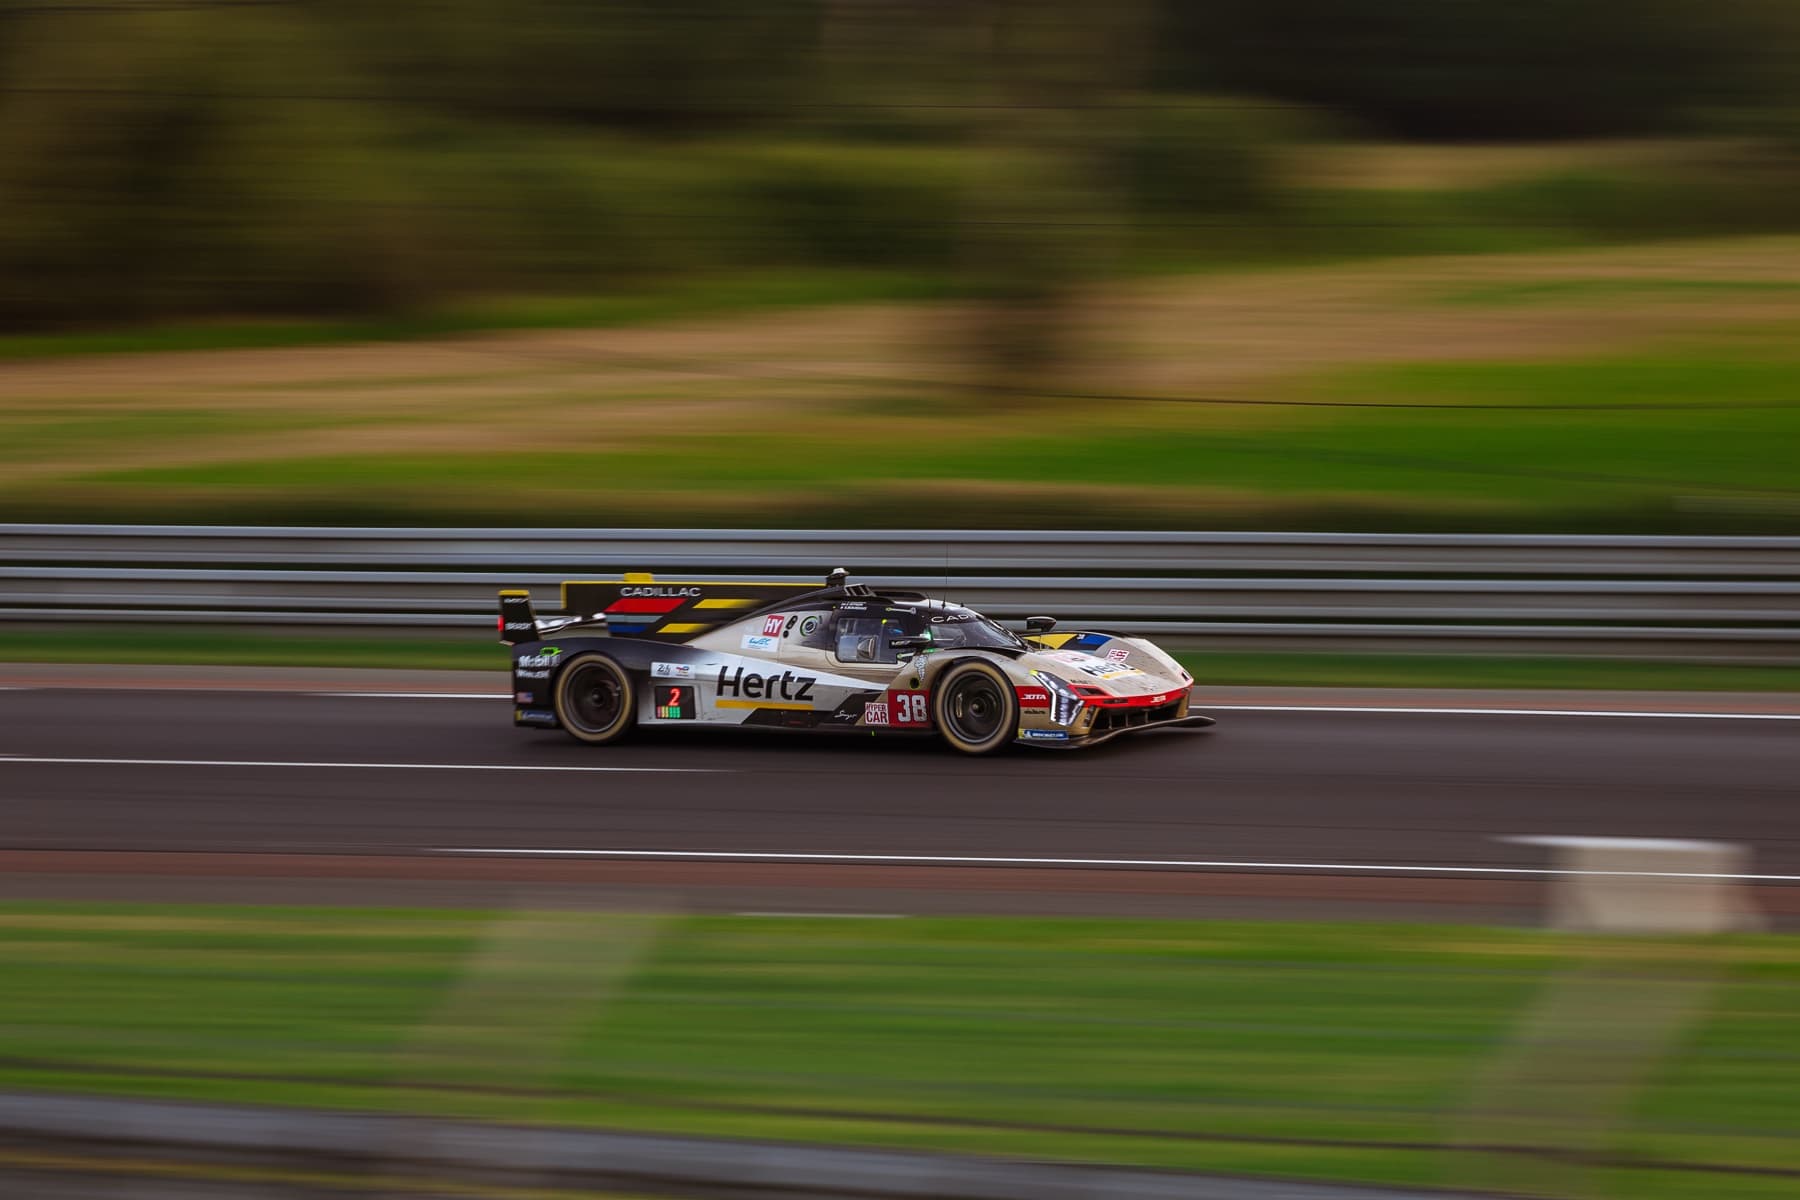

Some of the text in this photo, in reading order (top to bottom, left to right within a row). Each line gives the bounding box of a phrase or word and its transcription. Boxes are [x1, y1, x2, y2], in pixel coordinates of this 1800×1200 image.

[620, 586, 701, 597] CADILLAC
[764, 618, 782, 634] HY
[716, 665, 816, 701] Hertz
[668, 687, 680, 706] 2
[866, 703, 887, 712] HYPER
[896, 694, 928, 722] 38
[866, 711, 888, 723] CAR
